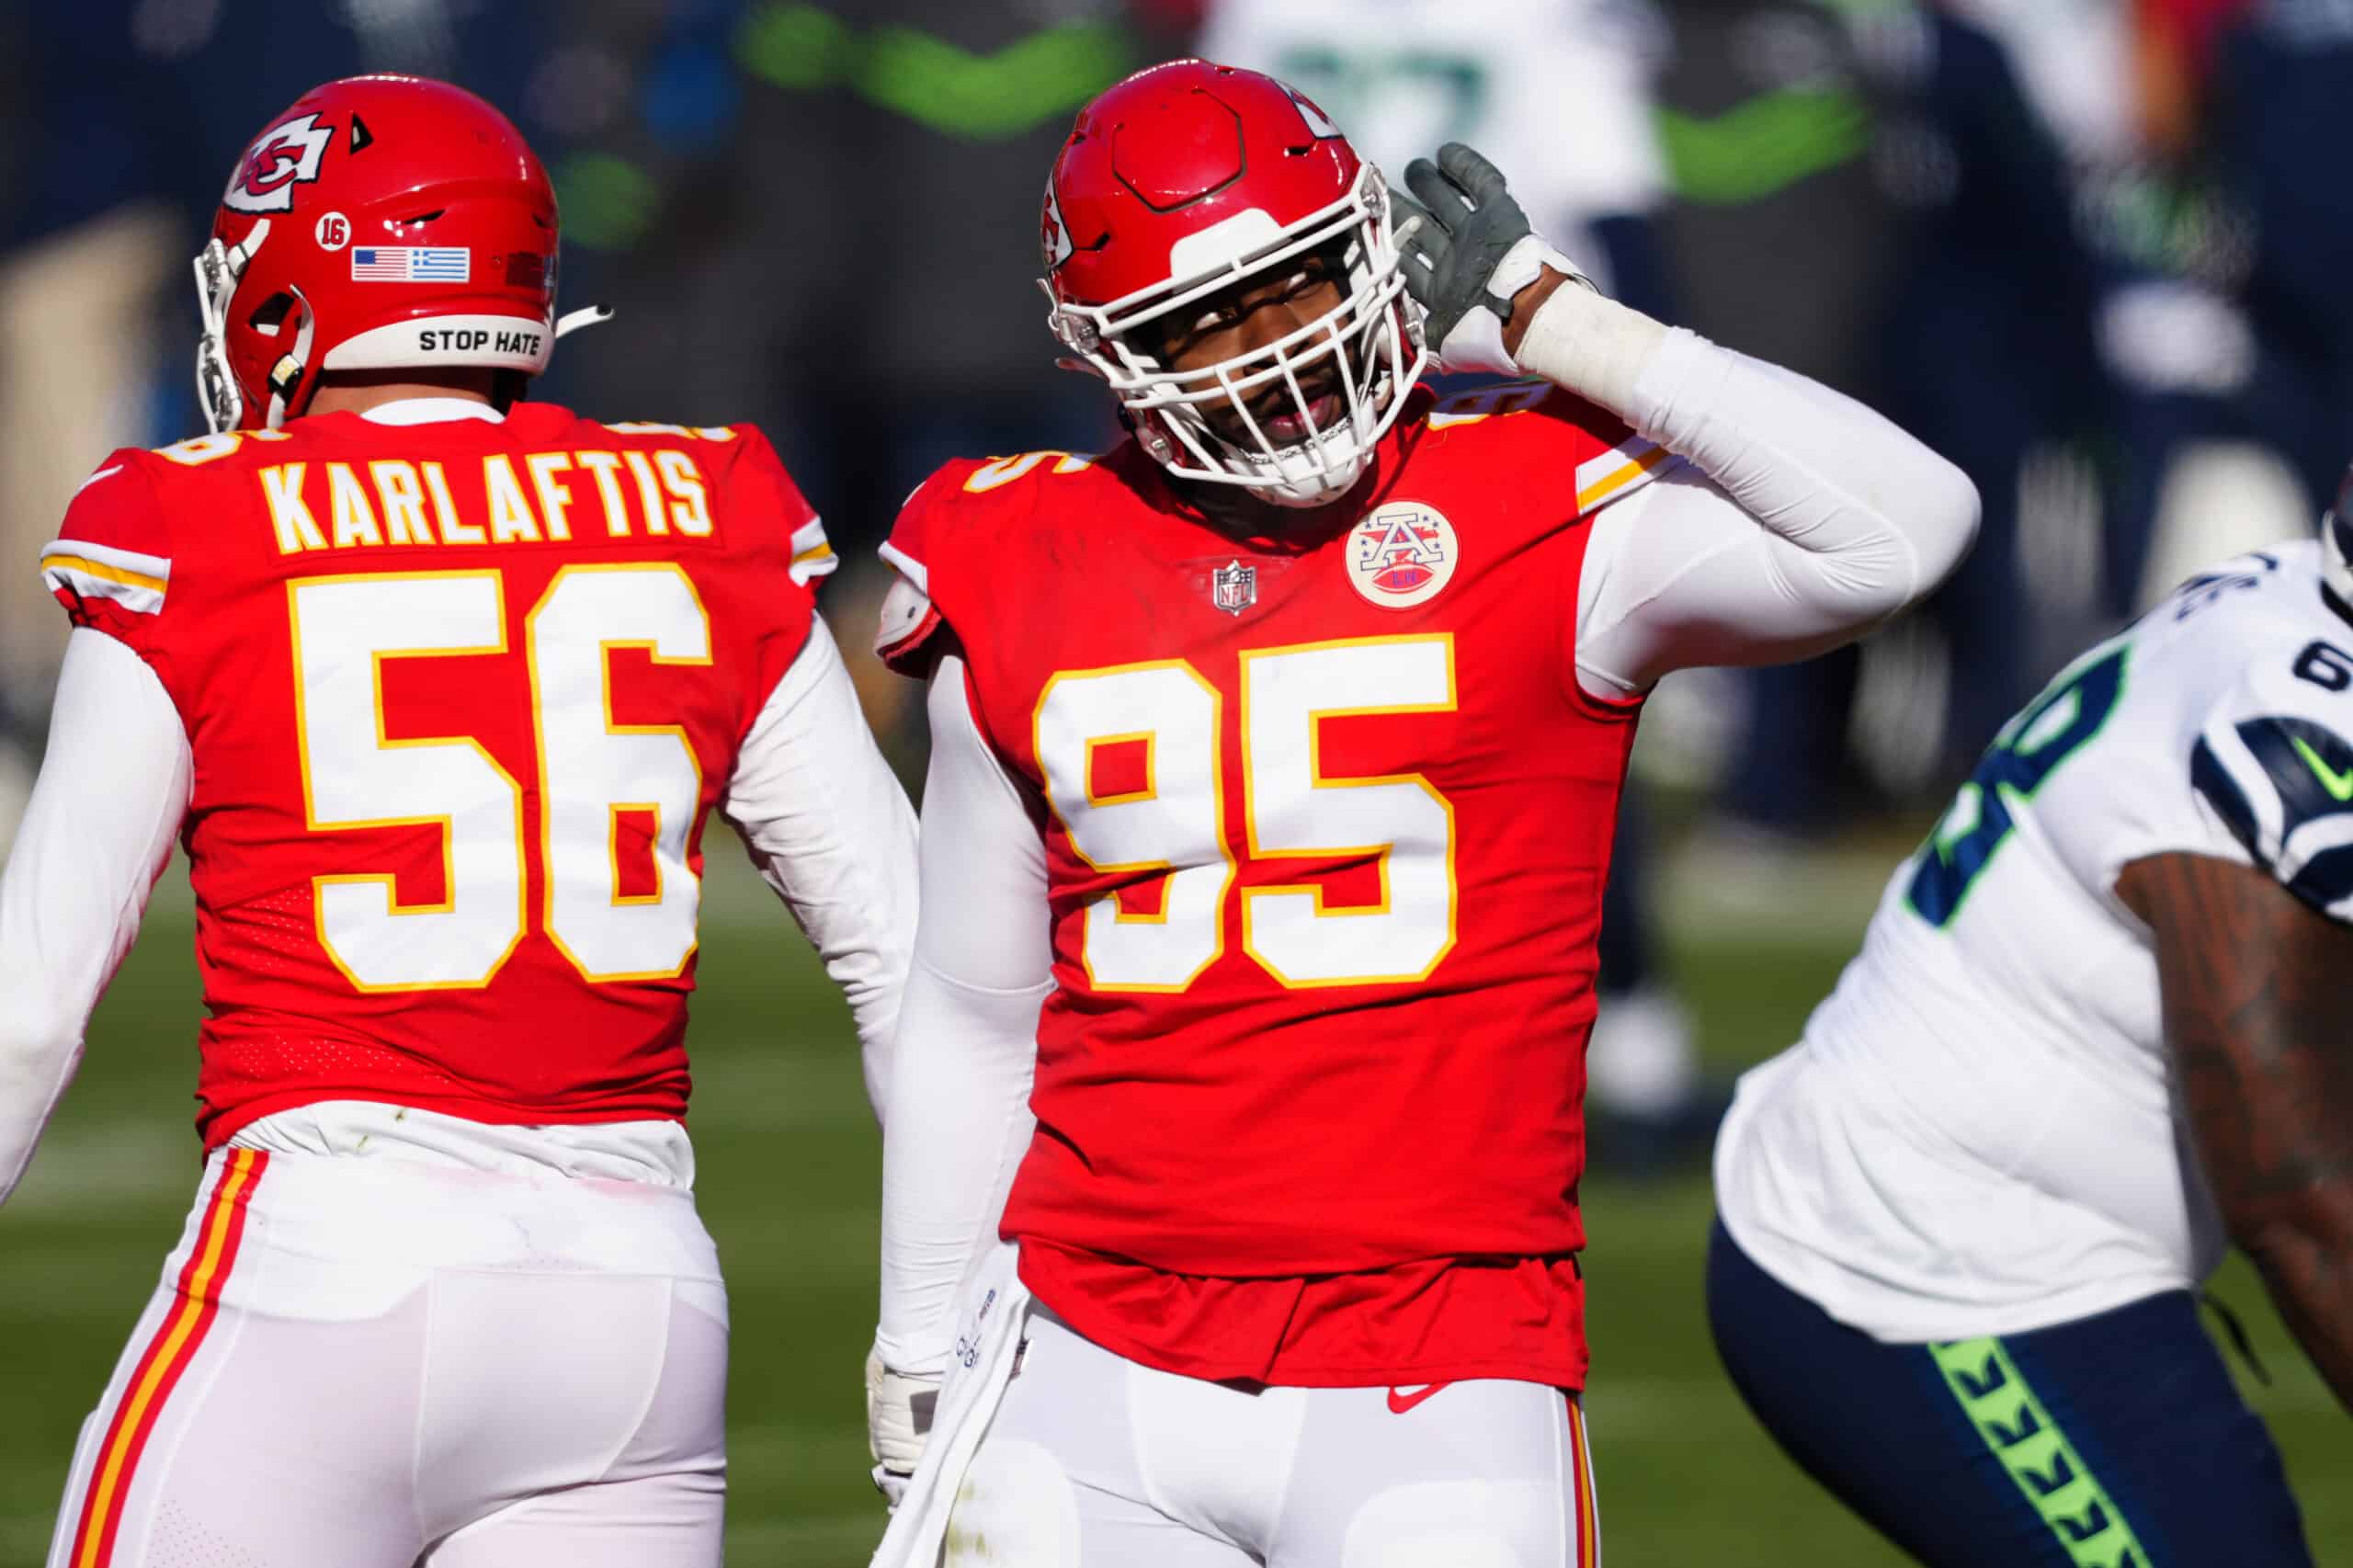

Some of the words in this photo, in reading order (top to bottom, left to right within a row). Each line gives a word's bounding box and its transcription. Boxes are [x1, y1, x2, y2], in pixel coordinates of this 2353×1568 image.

[322, 217, 346, 245] 16
[419, 330, 489, 351] STOP
[494, 331, 542, 357] HATE
[258, 449, 714, 555] KARLAFTIS
[1219, 583, 1251, 606] NFL
[287, 561, 713, 994] 56
[1032, 631, 1459, 994] 95
